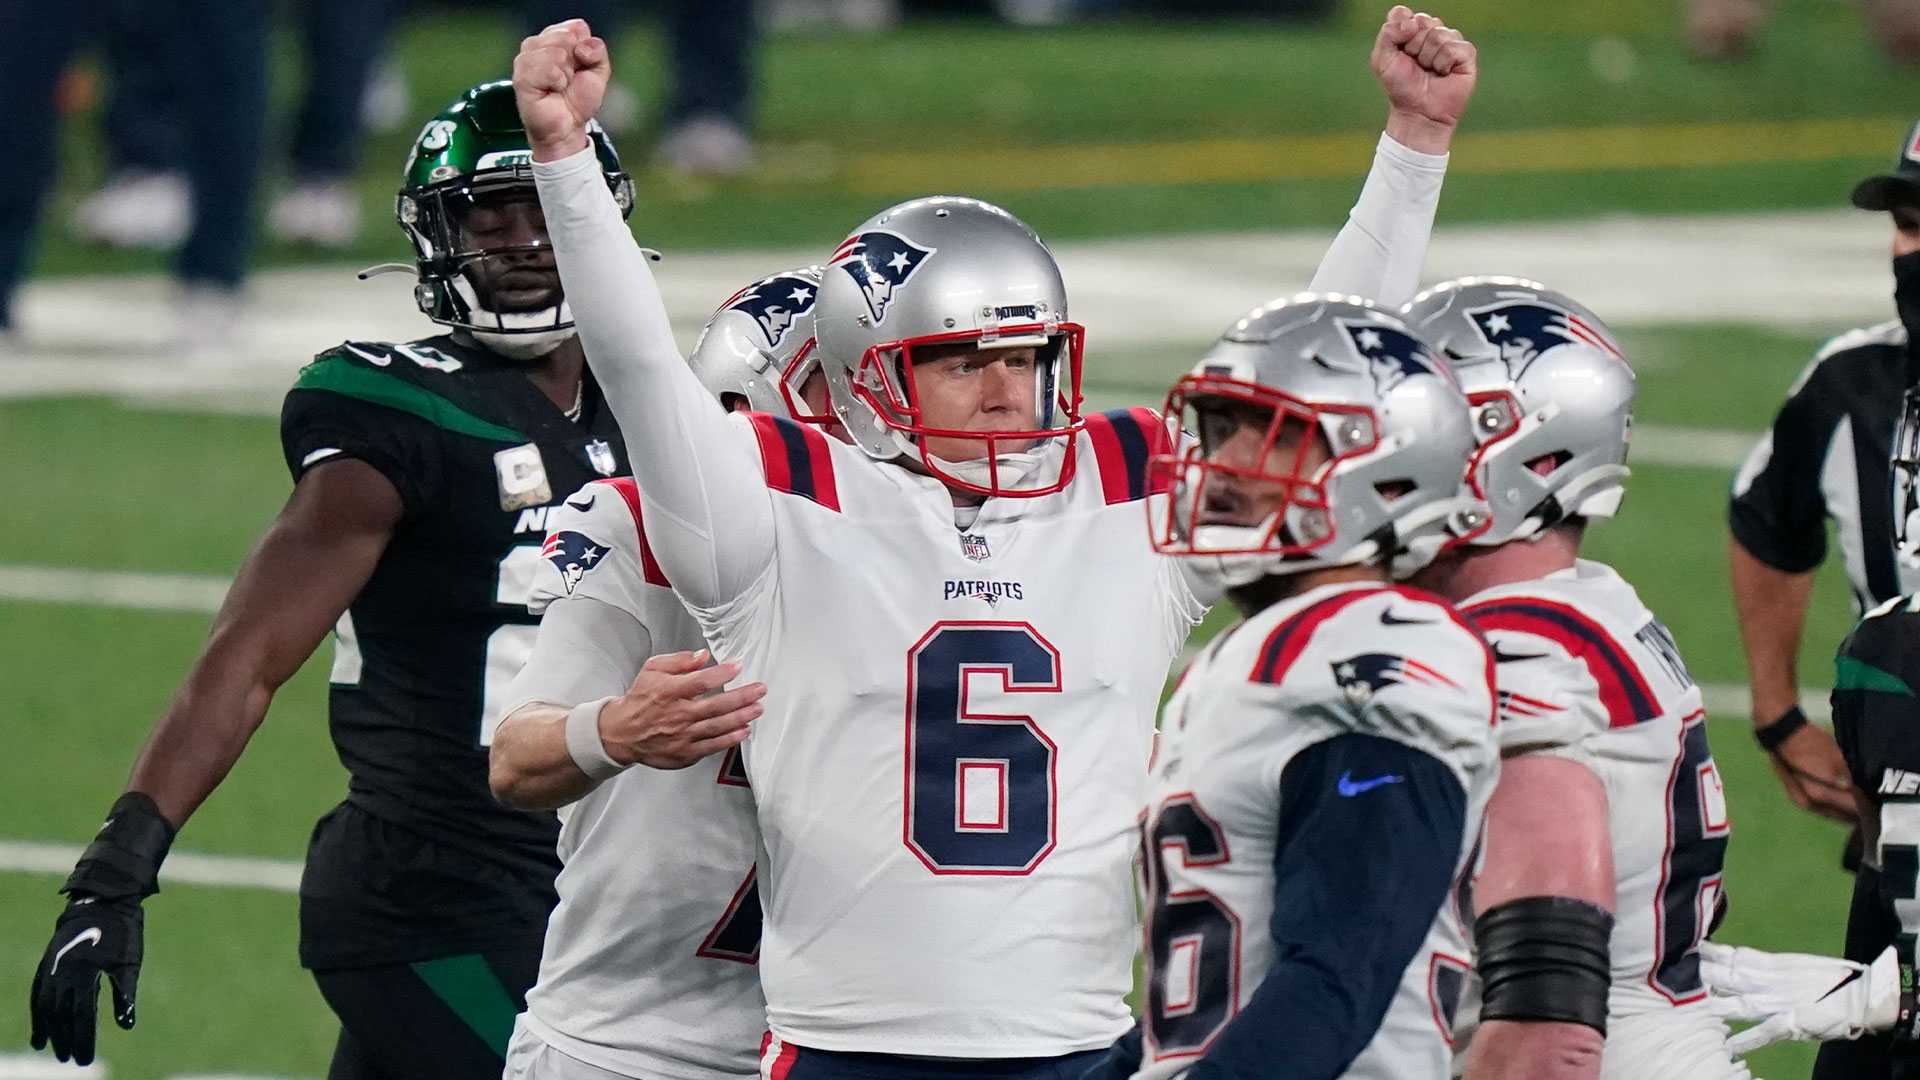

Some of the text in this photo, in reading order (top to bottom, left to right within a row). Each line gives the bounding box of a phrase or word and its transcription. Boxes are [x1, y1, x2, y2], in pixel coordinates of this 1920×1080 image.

[500, 449, 544, 495] C
[965, 543, 990, 557] NFL
[944, 580, 1024, 601] PATRIOTS
[903, 620, 1063, 875] 6
[1878, 767, 1920, 795] NE
